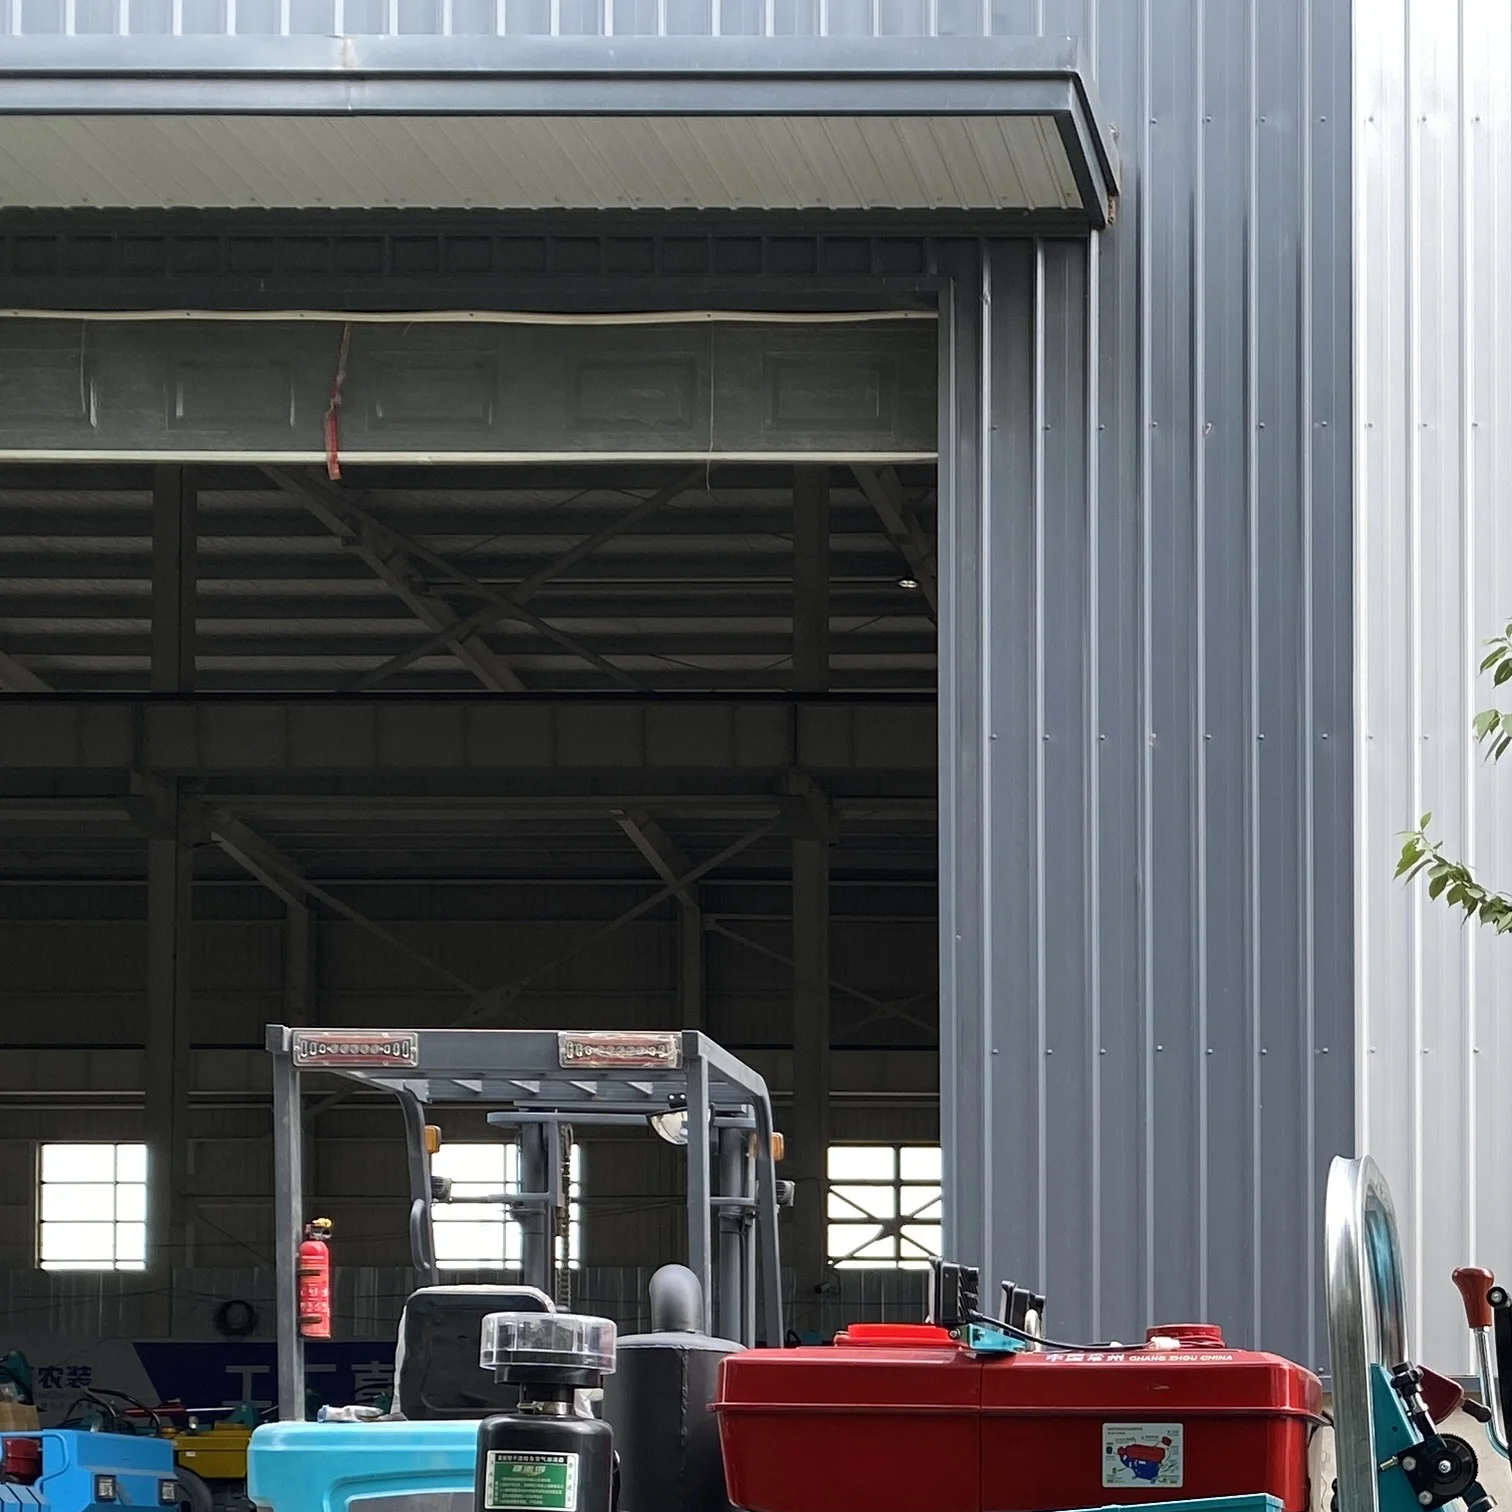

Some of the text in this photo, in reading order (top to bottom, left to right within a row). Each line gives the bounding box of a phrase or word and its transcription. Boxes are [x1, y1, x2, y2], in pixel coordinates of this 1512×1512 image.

[1168, 1354, 1198, 1362] ZHOU
[1199, 1354, 1233, 1362] CHINA
[32, 1365, 93, 1389] 农装
